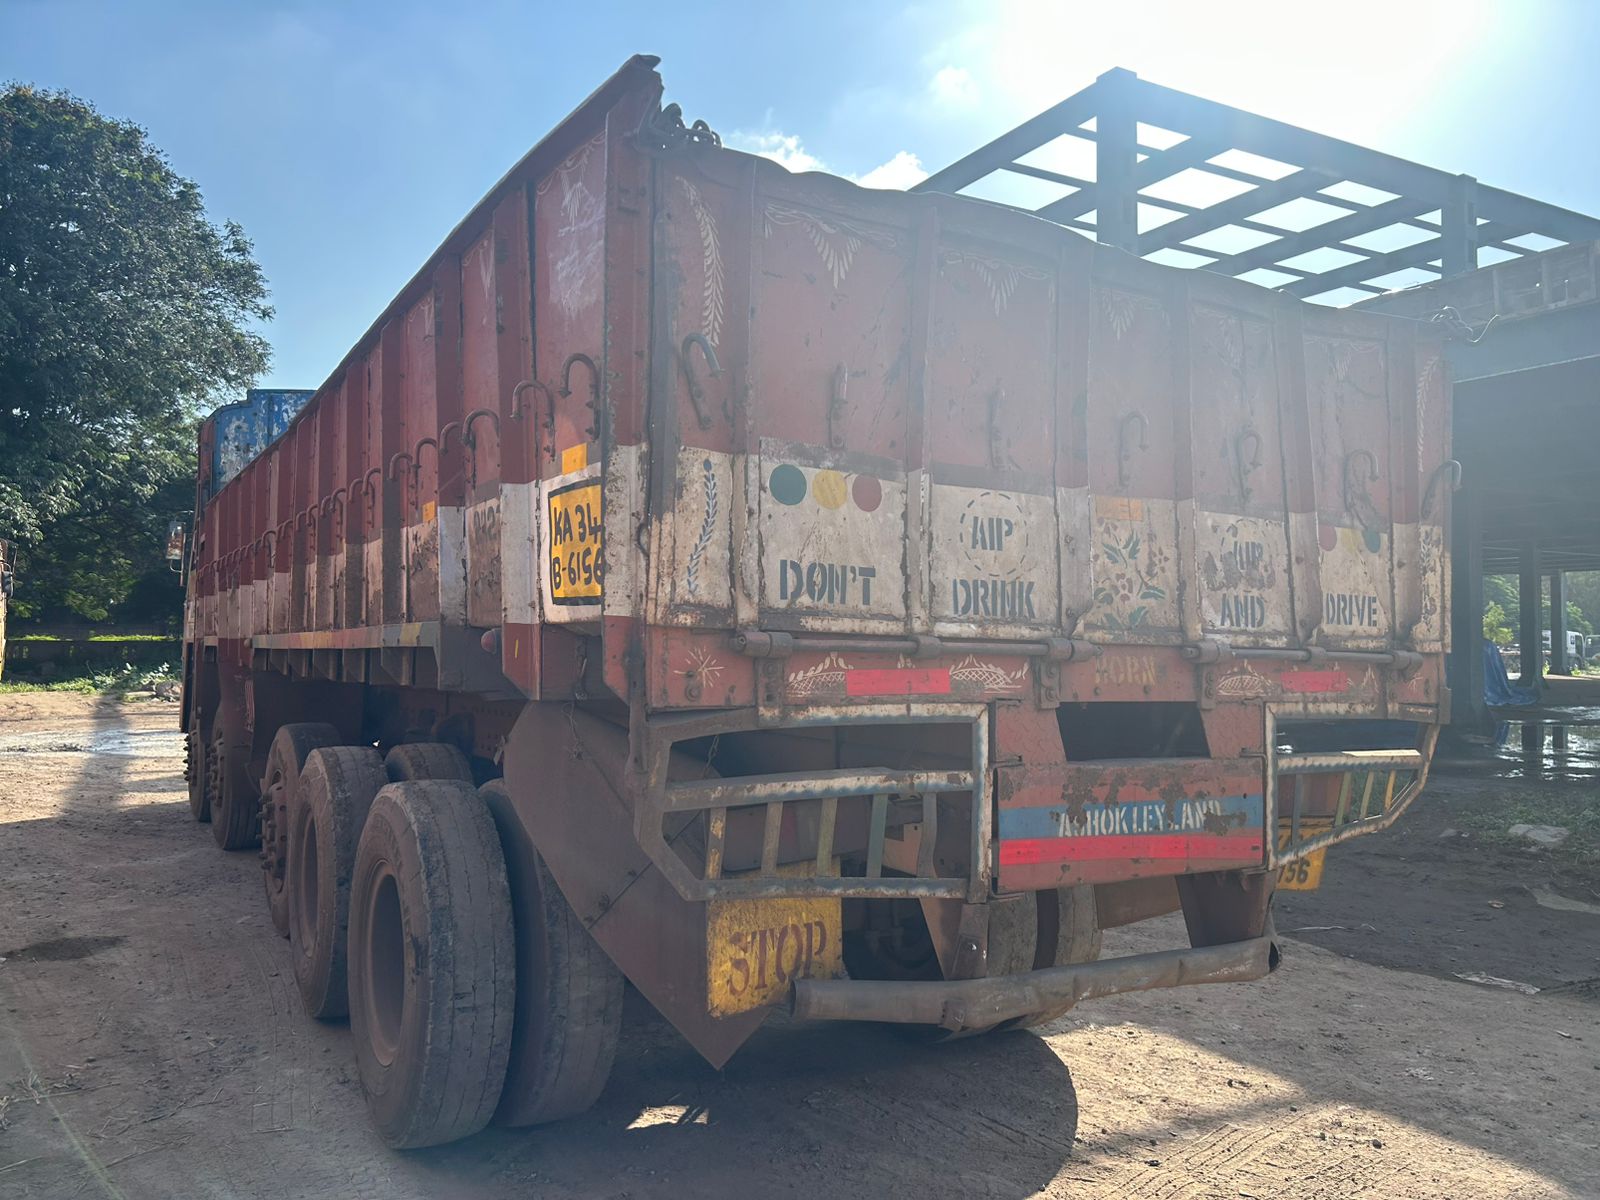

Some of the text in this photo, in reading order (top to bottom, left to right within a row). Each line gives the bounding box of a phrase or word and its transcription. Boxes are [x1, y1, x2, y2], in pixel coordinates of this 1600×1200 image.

[554, 503, 602, 546] KA 34
[553, 547, 603, 590] B-6156
[779, 559, 876, 606] DON'T
[952, 578, 1036, 619] DRINK
[1220, 593, 1265, 628] AND
[1325, 593, 1378, 628] DRIVE
[727, 921, 827, 996] STOP
